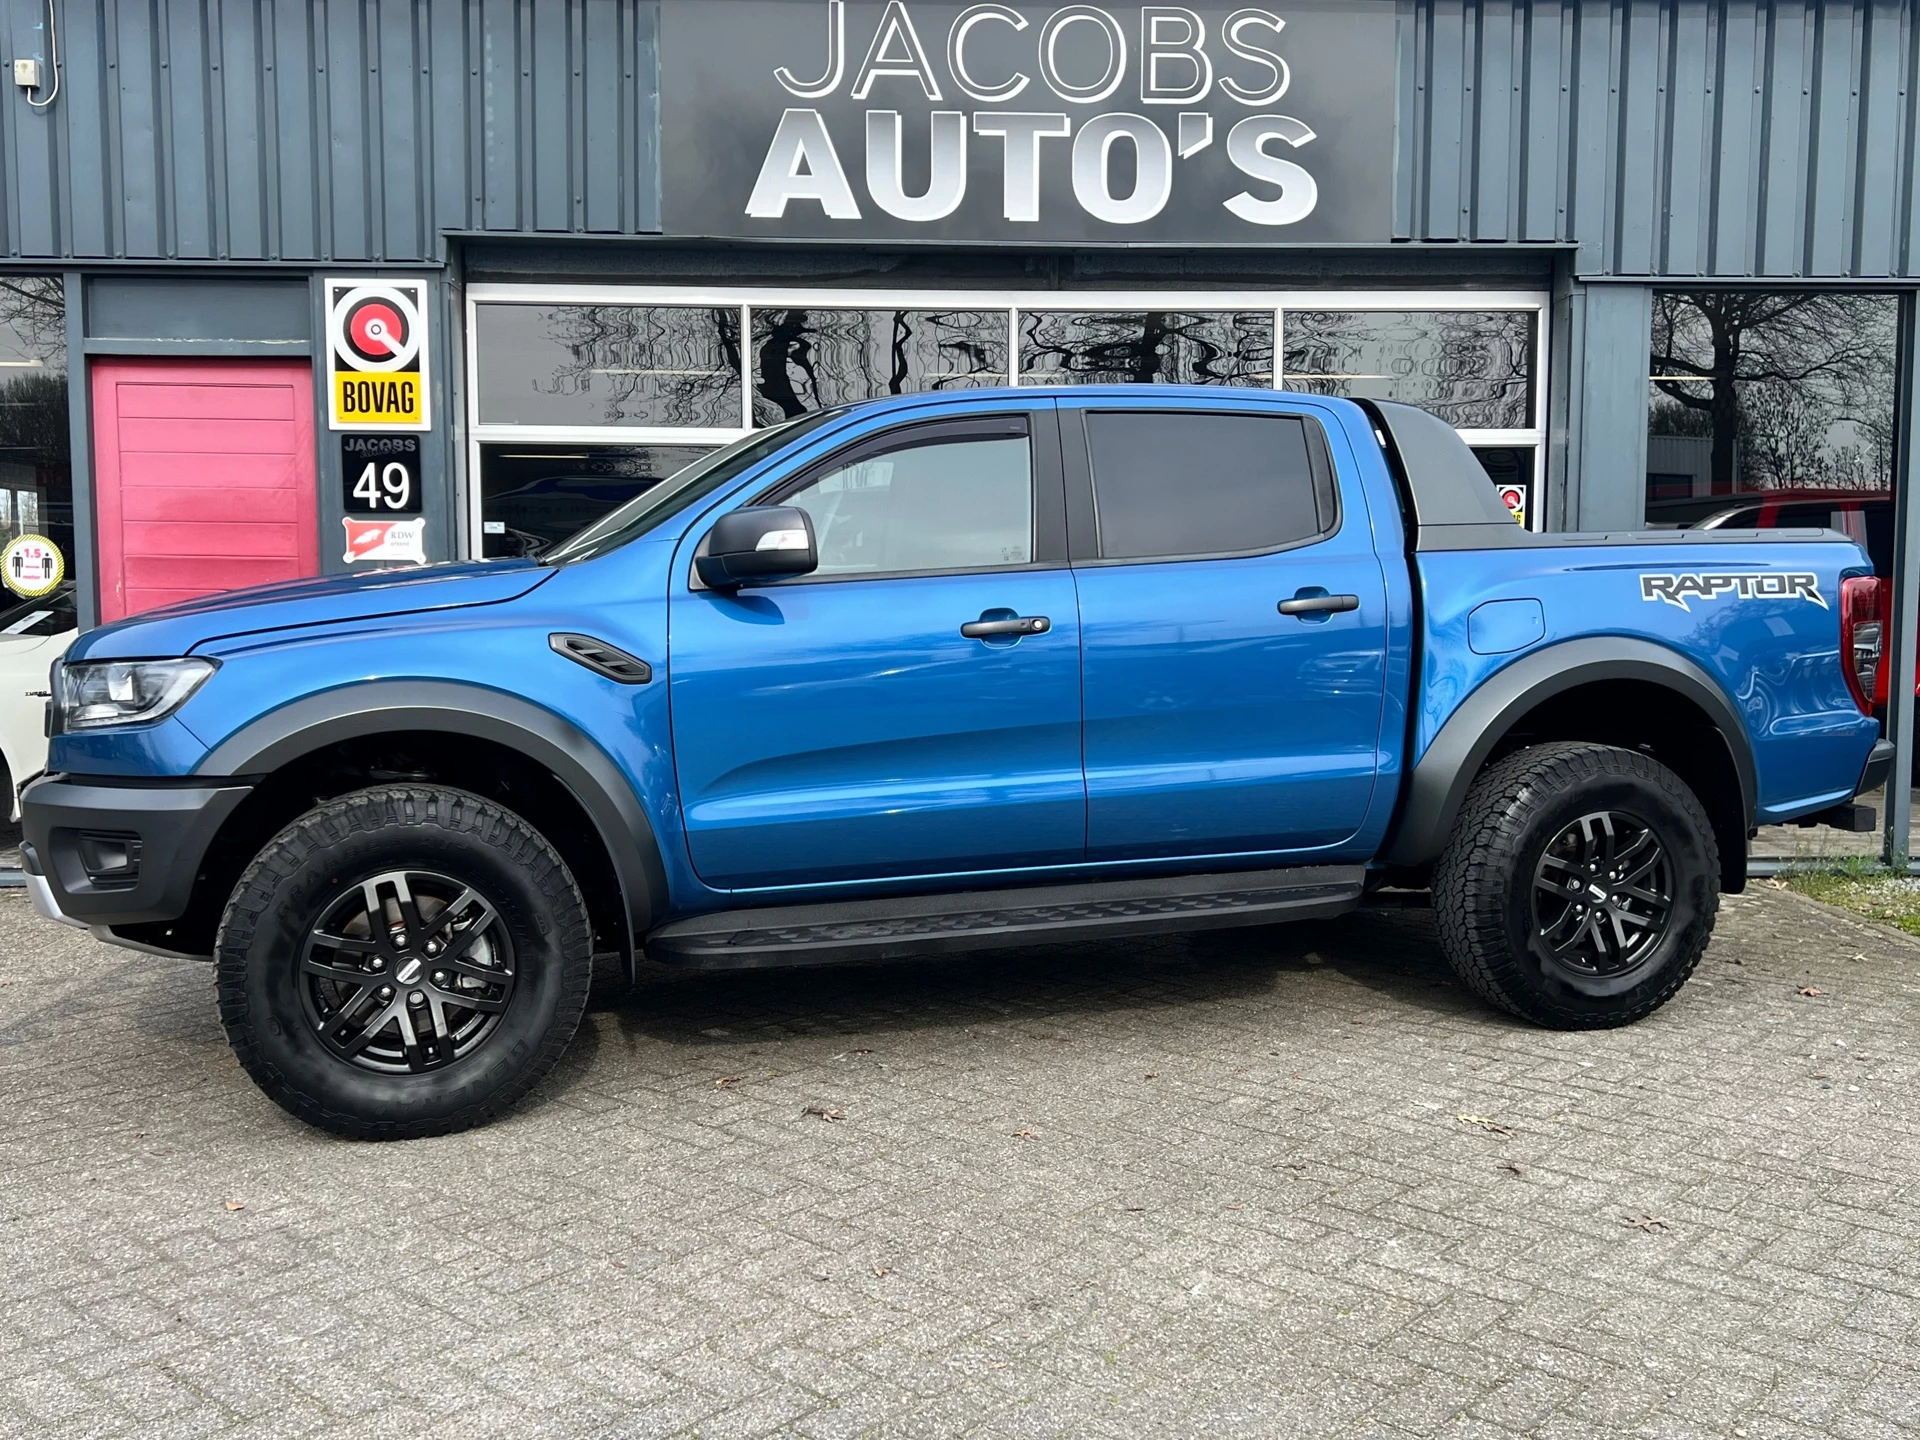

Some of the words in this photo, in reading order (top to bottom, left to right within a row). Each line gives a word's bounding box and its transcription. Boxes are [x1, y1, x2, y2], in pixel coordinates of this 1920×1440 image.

[773, 0, 1291, 105] JACOBS
[744, 107, 1318, 226] AUTO'S
[343, 380, 414, 414] BOVAG
[344, 438, 416, 452] JACOBS
[353, 462, 410, 509] 49
[24, 547, 41, 559] 1.5
[390, 531, 415, 539] RDW
[1639, 571, 1829, 613] RAPTOR
